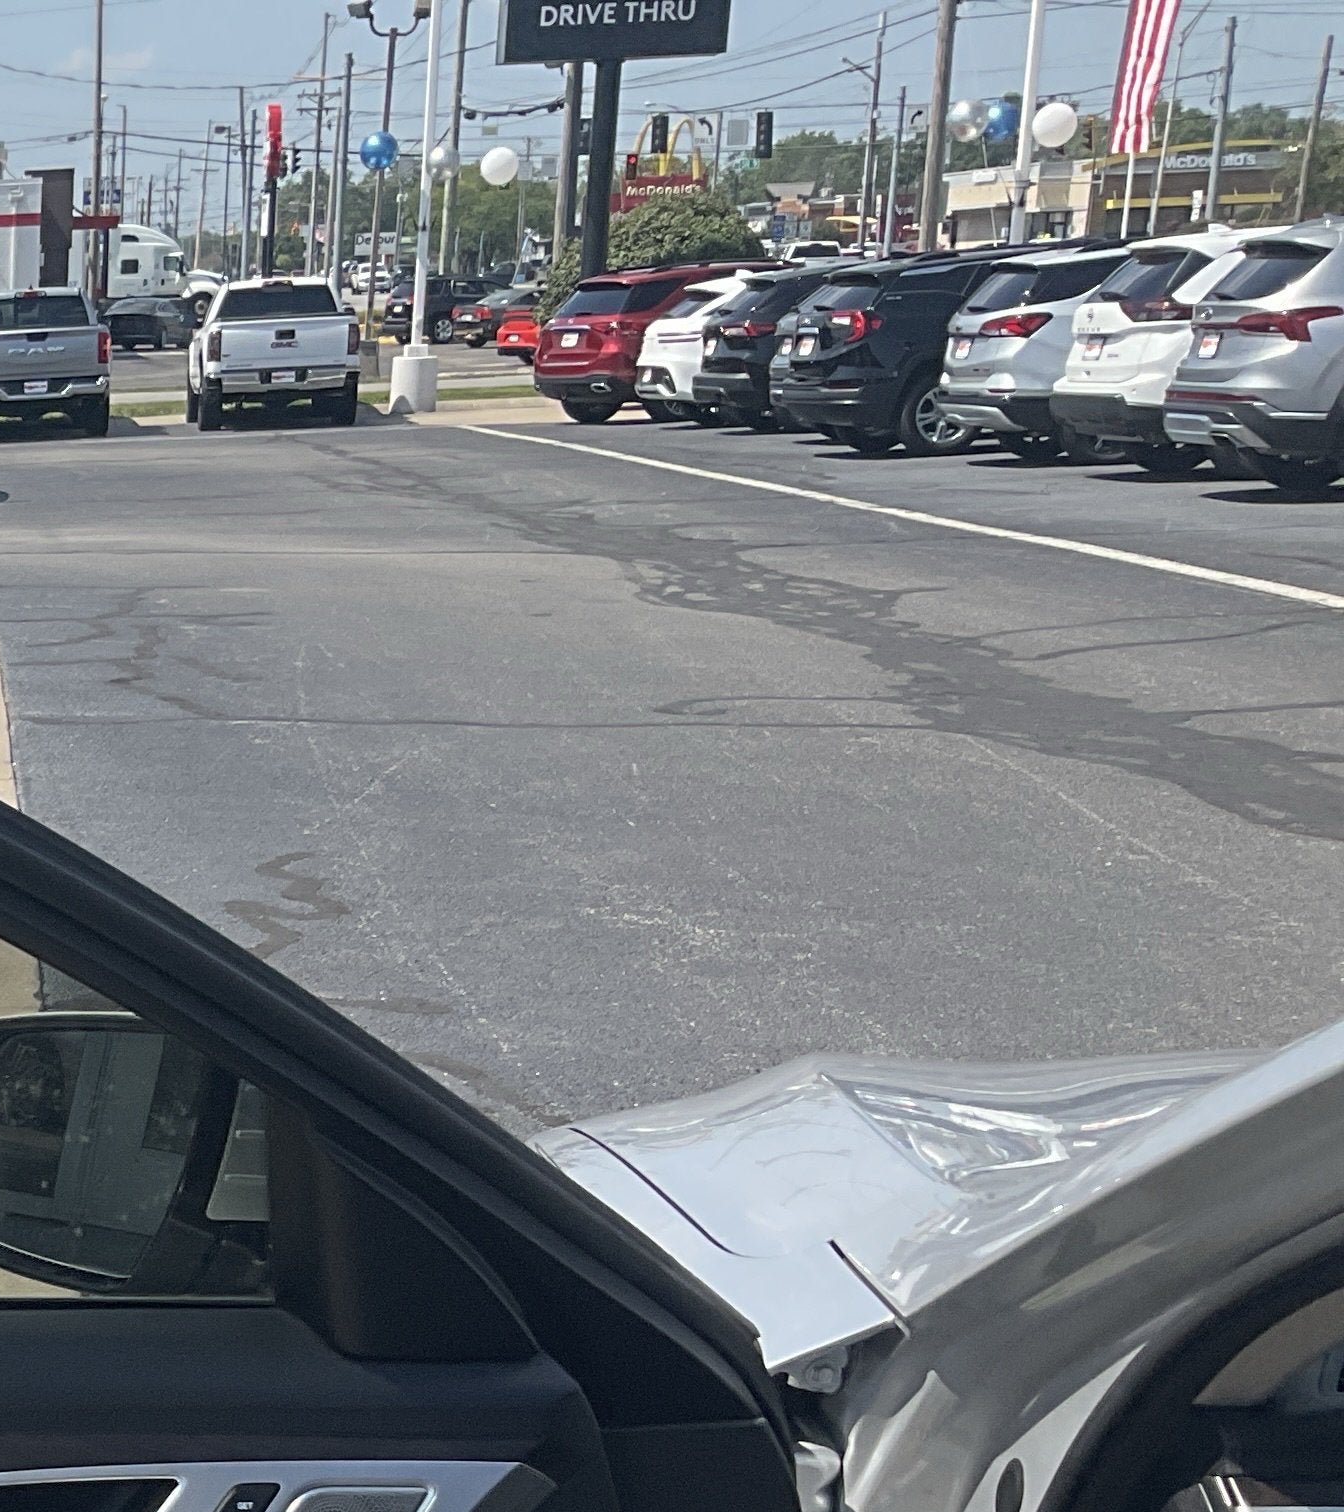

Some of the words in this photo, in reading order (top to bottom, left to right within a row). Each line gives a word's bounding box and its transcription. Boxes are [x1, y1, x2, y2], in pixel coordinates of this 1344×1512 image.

[540, 2, 616, 27] DRIVE
[624, 0, 697, 23] THRU
[1164, 153, 1257, 168] McDoald's
[626, 184, 701, 197] McDonald's
[355, 234, 396, 246] Deour
[270, 341, 298, 349] GMC
